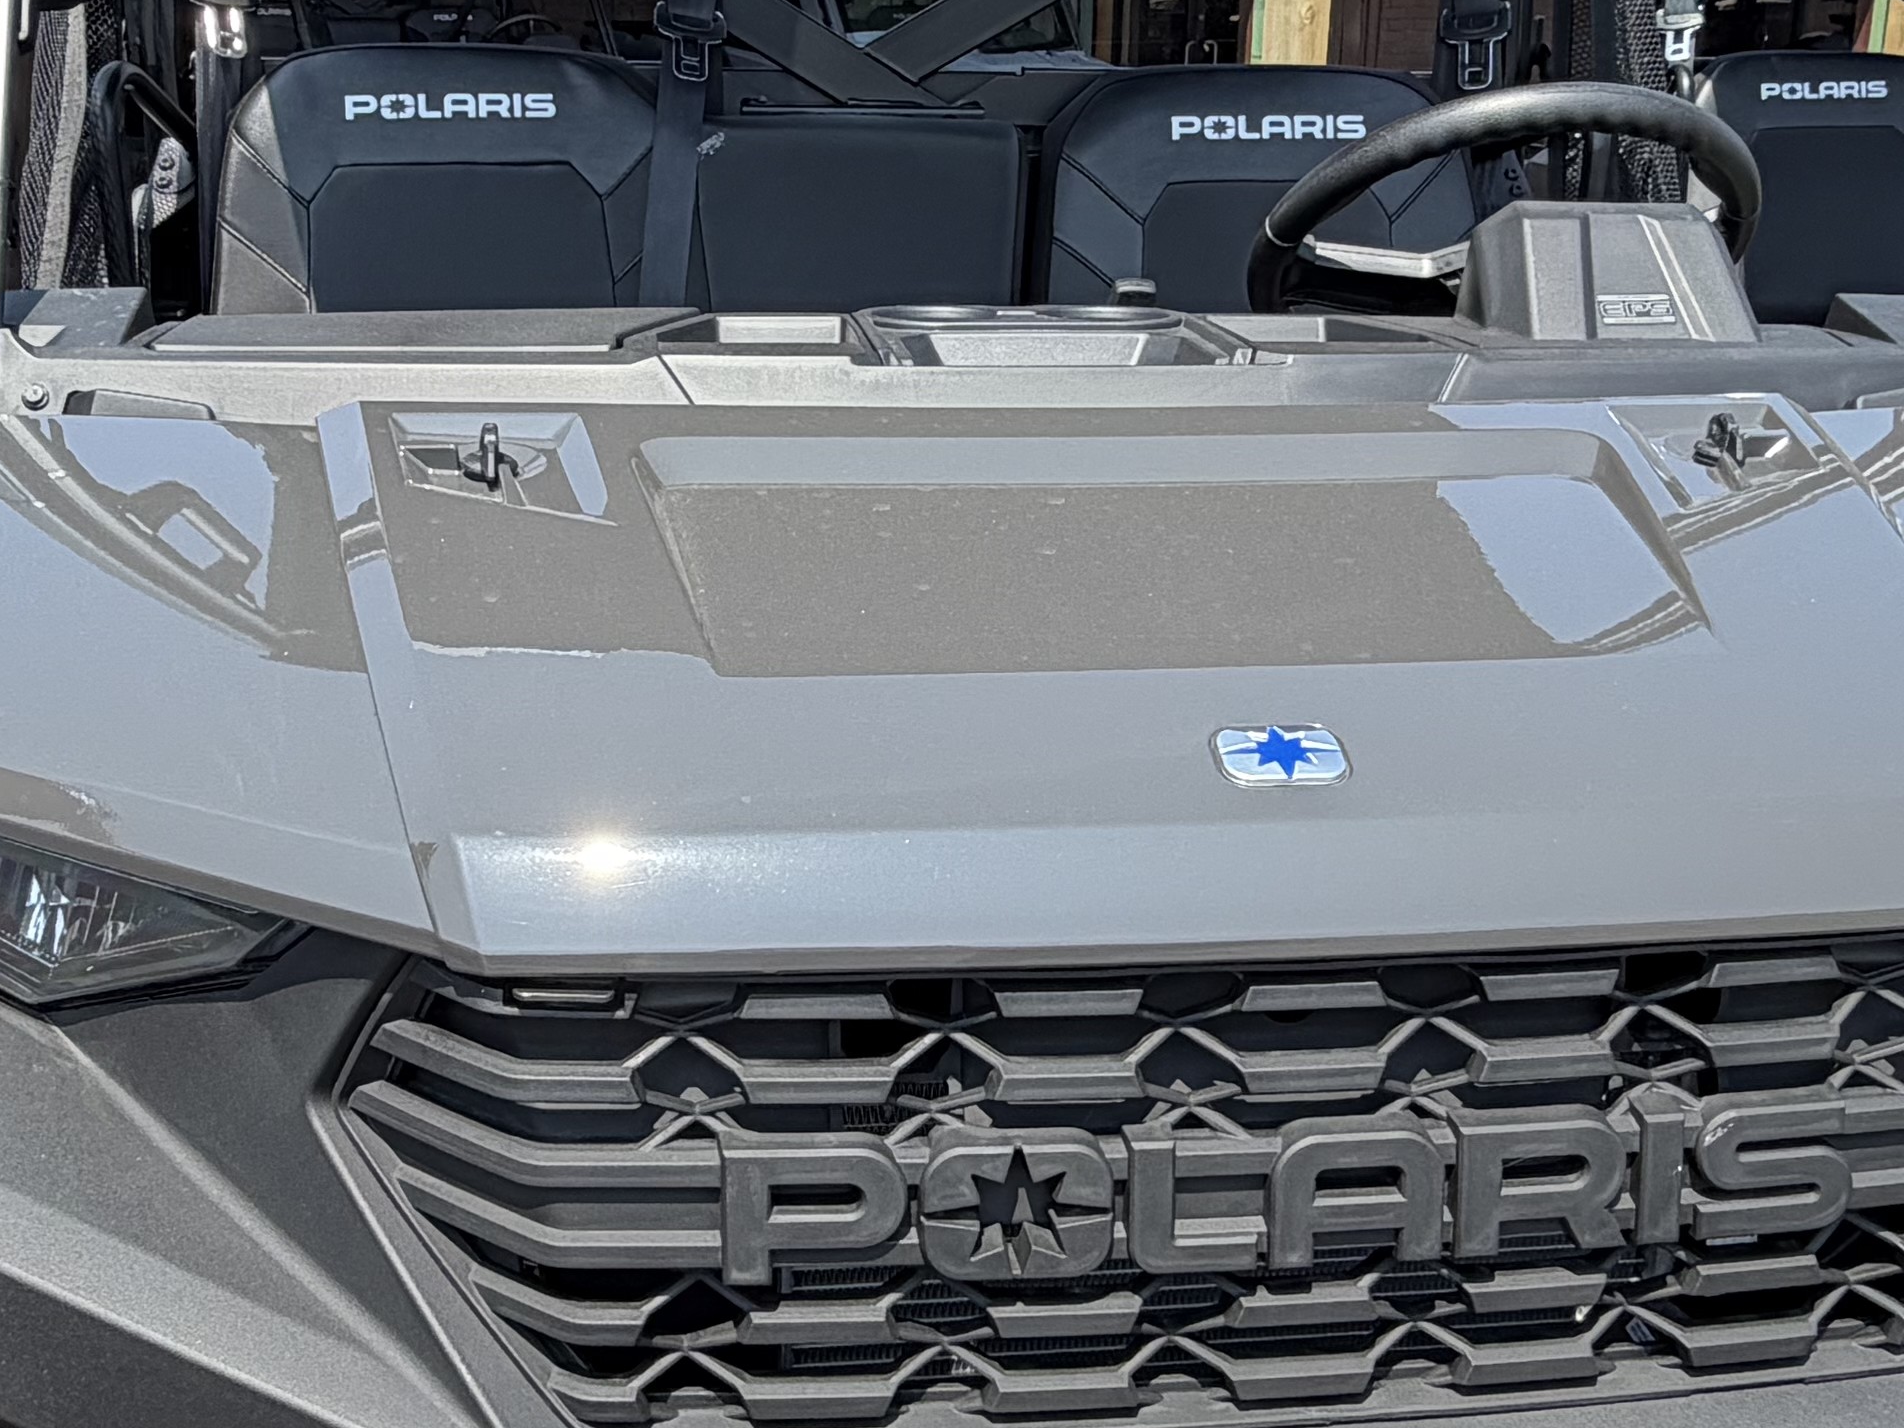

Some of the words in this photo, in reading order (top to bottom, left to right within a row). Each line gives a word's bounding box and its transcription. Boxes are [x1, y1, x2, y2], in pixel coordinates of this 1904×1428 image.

[1760, 80, 1889, 101] POLARIS
[344, 92, 557, 121] POLARIS
[1170, 114, 1367, 141] POLARIS
[1599, 300, 1673, 317] EPS
[718, 1090, 1853, 1287] POLARIS
